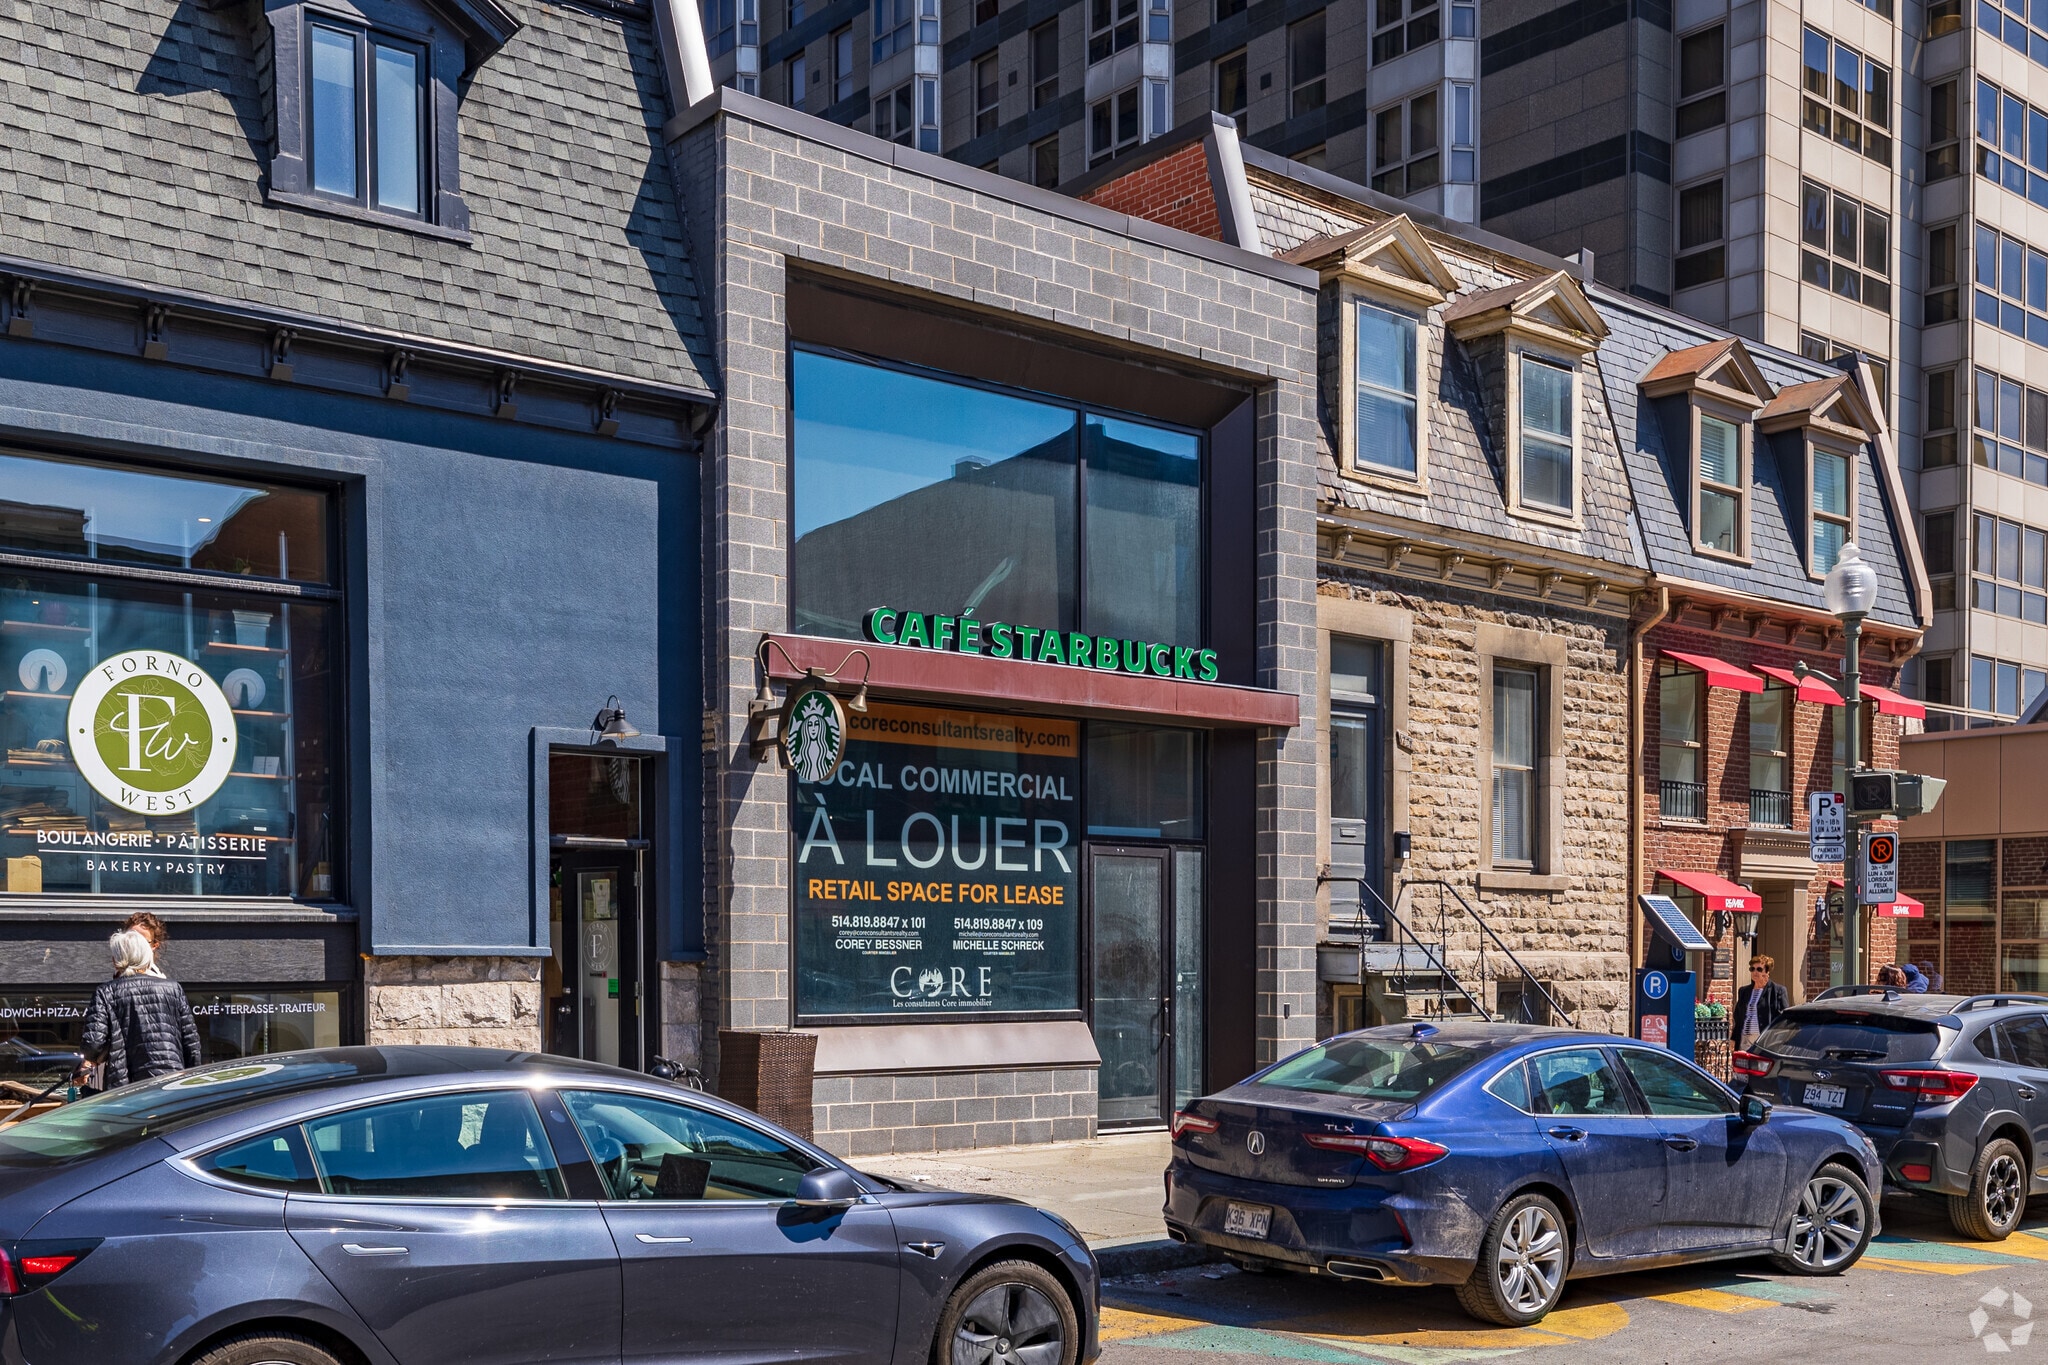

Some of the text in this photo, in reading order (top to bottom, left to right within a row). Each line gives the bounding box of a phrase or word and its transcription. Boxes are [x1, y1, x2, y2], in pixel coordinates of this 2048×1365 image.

[865, 605, 1219, 683] CAFÉ STARBUCKS
[102, 655, 204, 689] FORNO
[798, 759, 1074, 801] CAL COMMERCIAL
[119, 787, 195, 811] WEST
[36, 830, 267, 852] BOULANGERIE PÂTISSERIE
[798, 792, 1073, 874] À LOUER
[86, 859, 226, 875] BAKERY PASTRY
[808, 878, 1064, 905] RETAIL SPACE FOR LEASE
[831, 915, 926, 929] 514.819.8847 x 101
[953, 917, 1044, 931] 514.819.8847 x 109
[835, 938, 923, 950] COREY BESSNER
[952, 939, 1045, 951] MICHELLE SCHRECK
[890, 965, 992, 998] CORE
[192, 1002, 326, 1015] CAFÉ TERRASSE TRAITEUR
[892, 998, 993, 1008] Les consultants Core immobilier
[47, 1007, 80, 1018] PIZZA
[1804, 1087, 1846, 1104] Z94 TZT
[1324, 1122, 1355, 1134] TLX
[1226, 1208, 1270, 1231] K36 XPN
